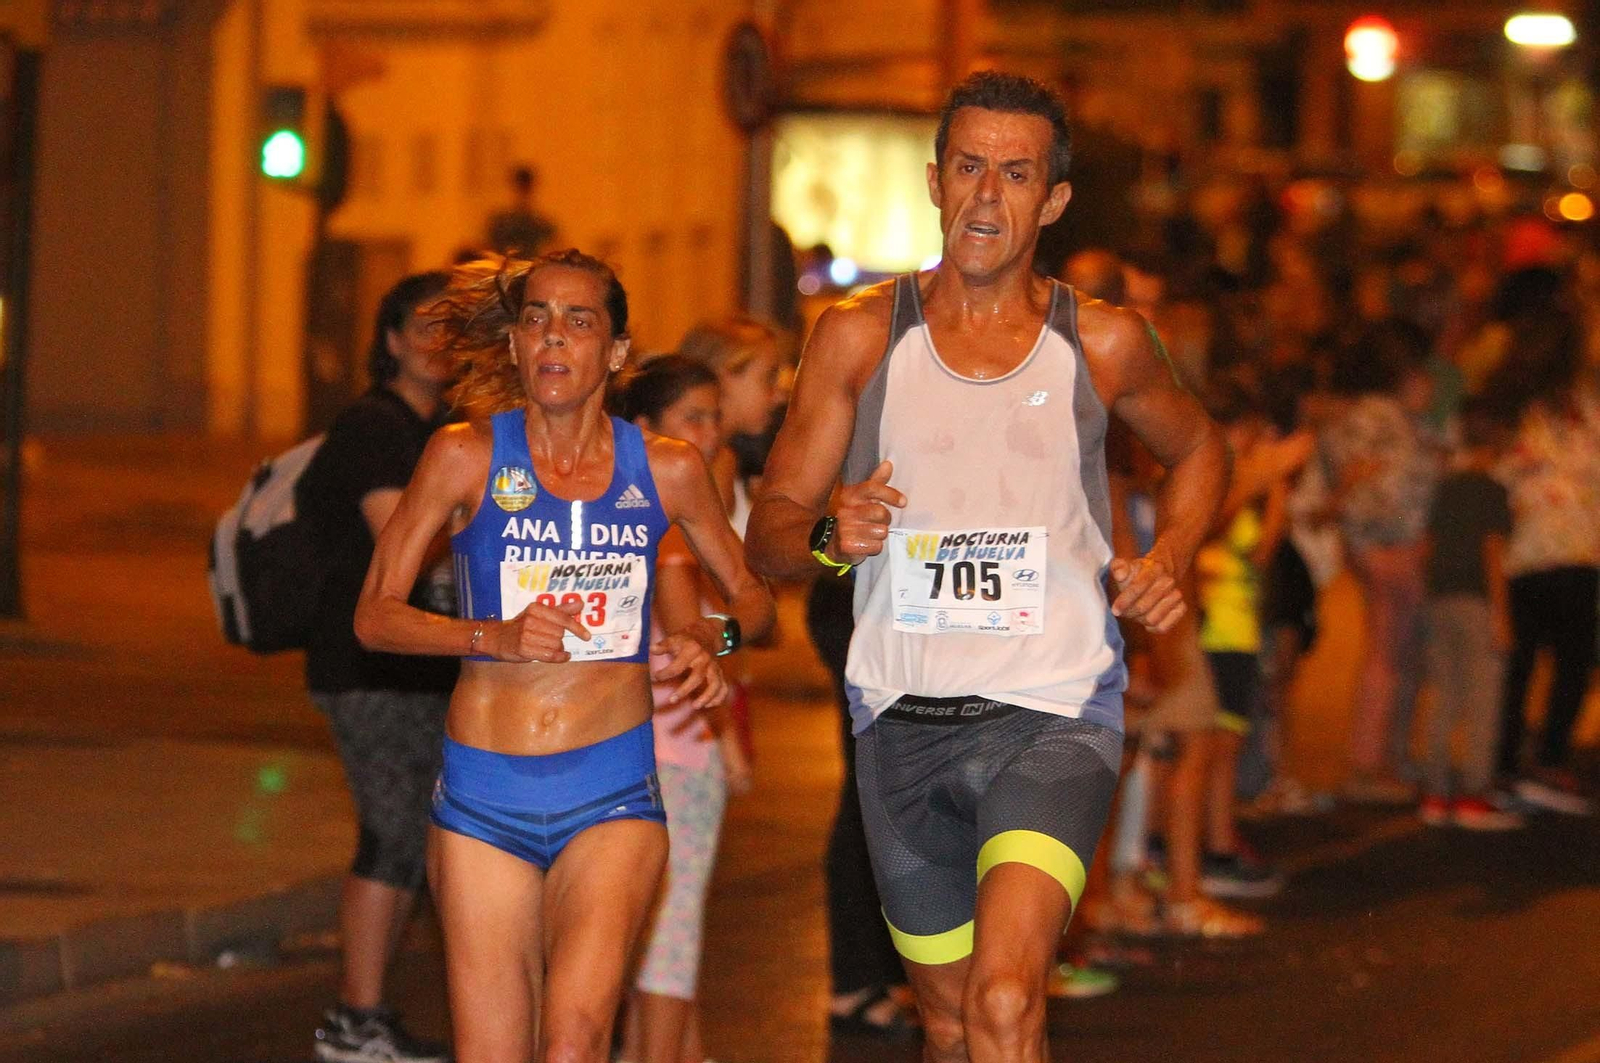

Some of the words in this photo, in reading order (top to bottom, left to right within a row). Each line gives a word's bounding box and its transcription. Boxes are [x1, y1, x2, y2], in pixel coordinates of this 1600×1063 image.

[615, 500, 650, 509] adidas
[501, 517, 560, 543] ANA
[591, 524, 648, 547] DIAS
[940, 532, 1029, 548] NOCTURNA
[504, 545, 637, 563] RUNN
[936, 548, 959, 562] DE
[963, 546, 1025, 561] HUELVA
[550, 562, 632, 579] NOCTURNA
[547, 577, 568, 592] DE
[572, 576, 630, 592] HUELVA
[924, 561, 1001, 601] 705
[891, 703, 956, 716] INVERSE
